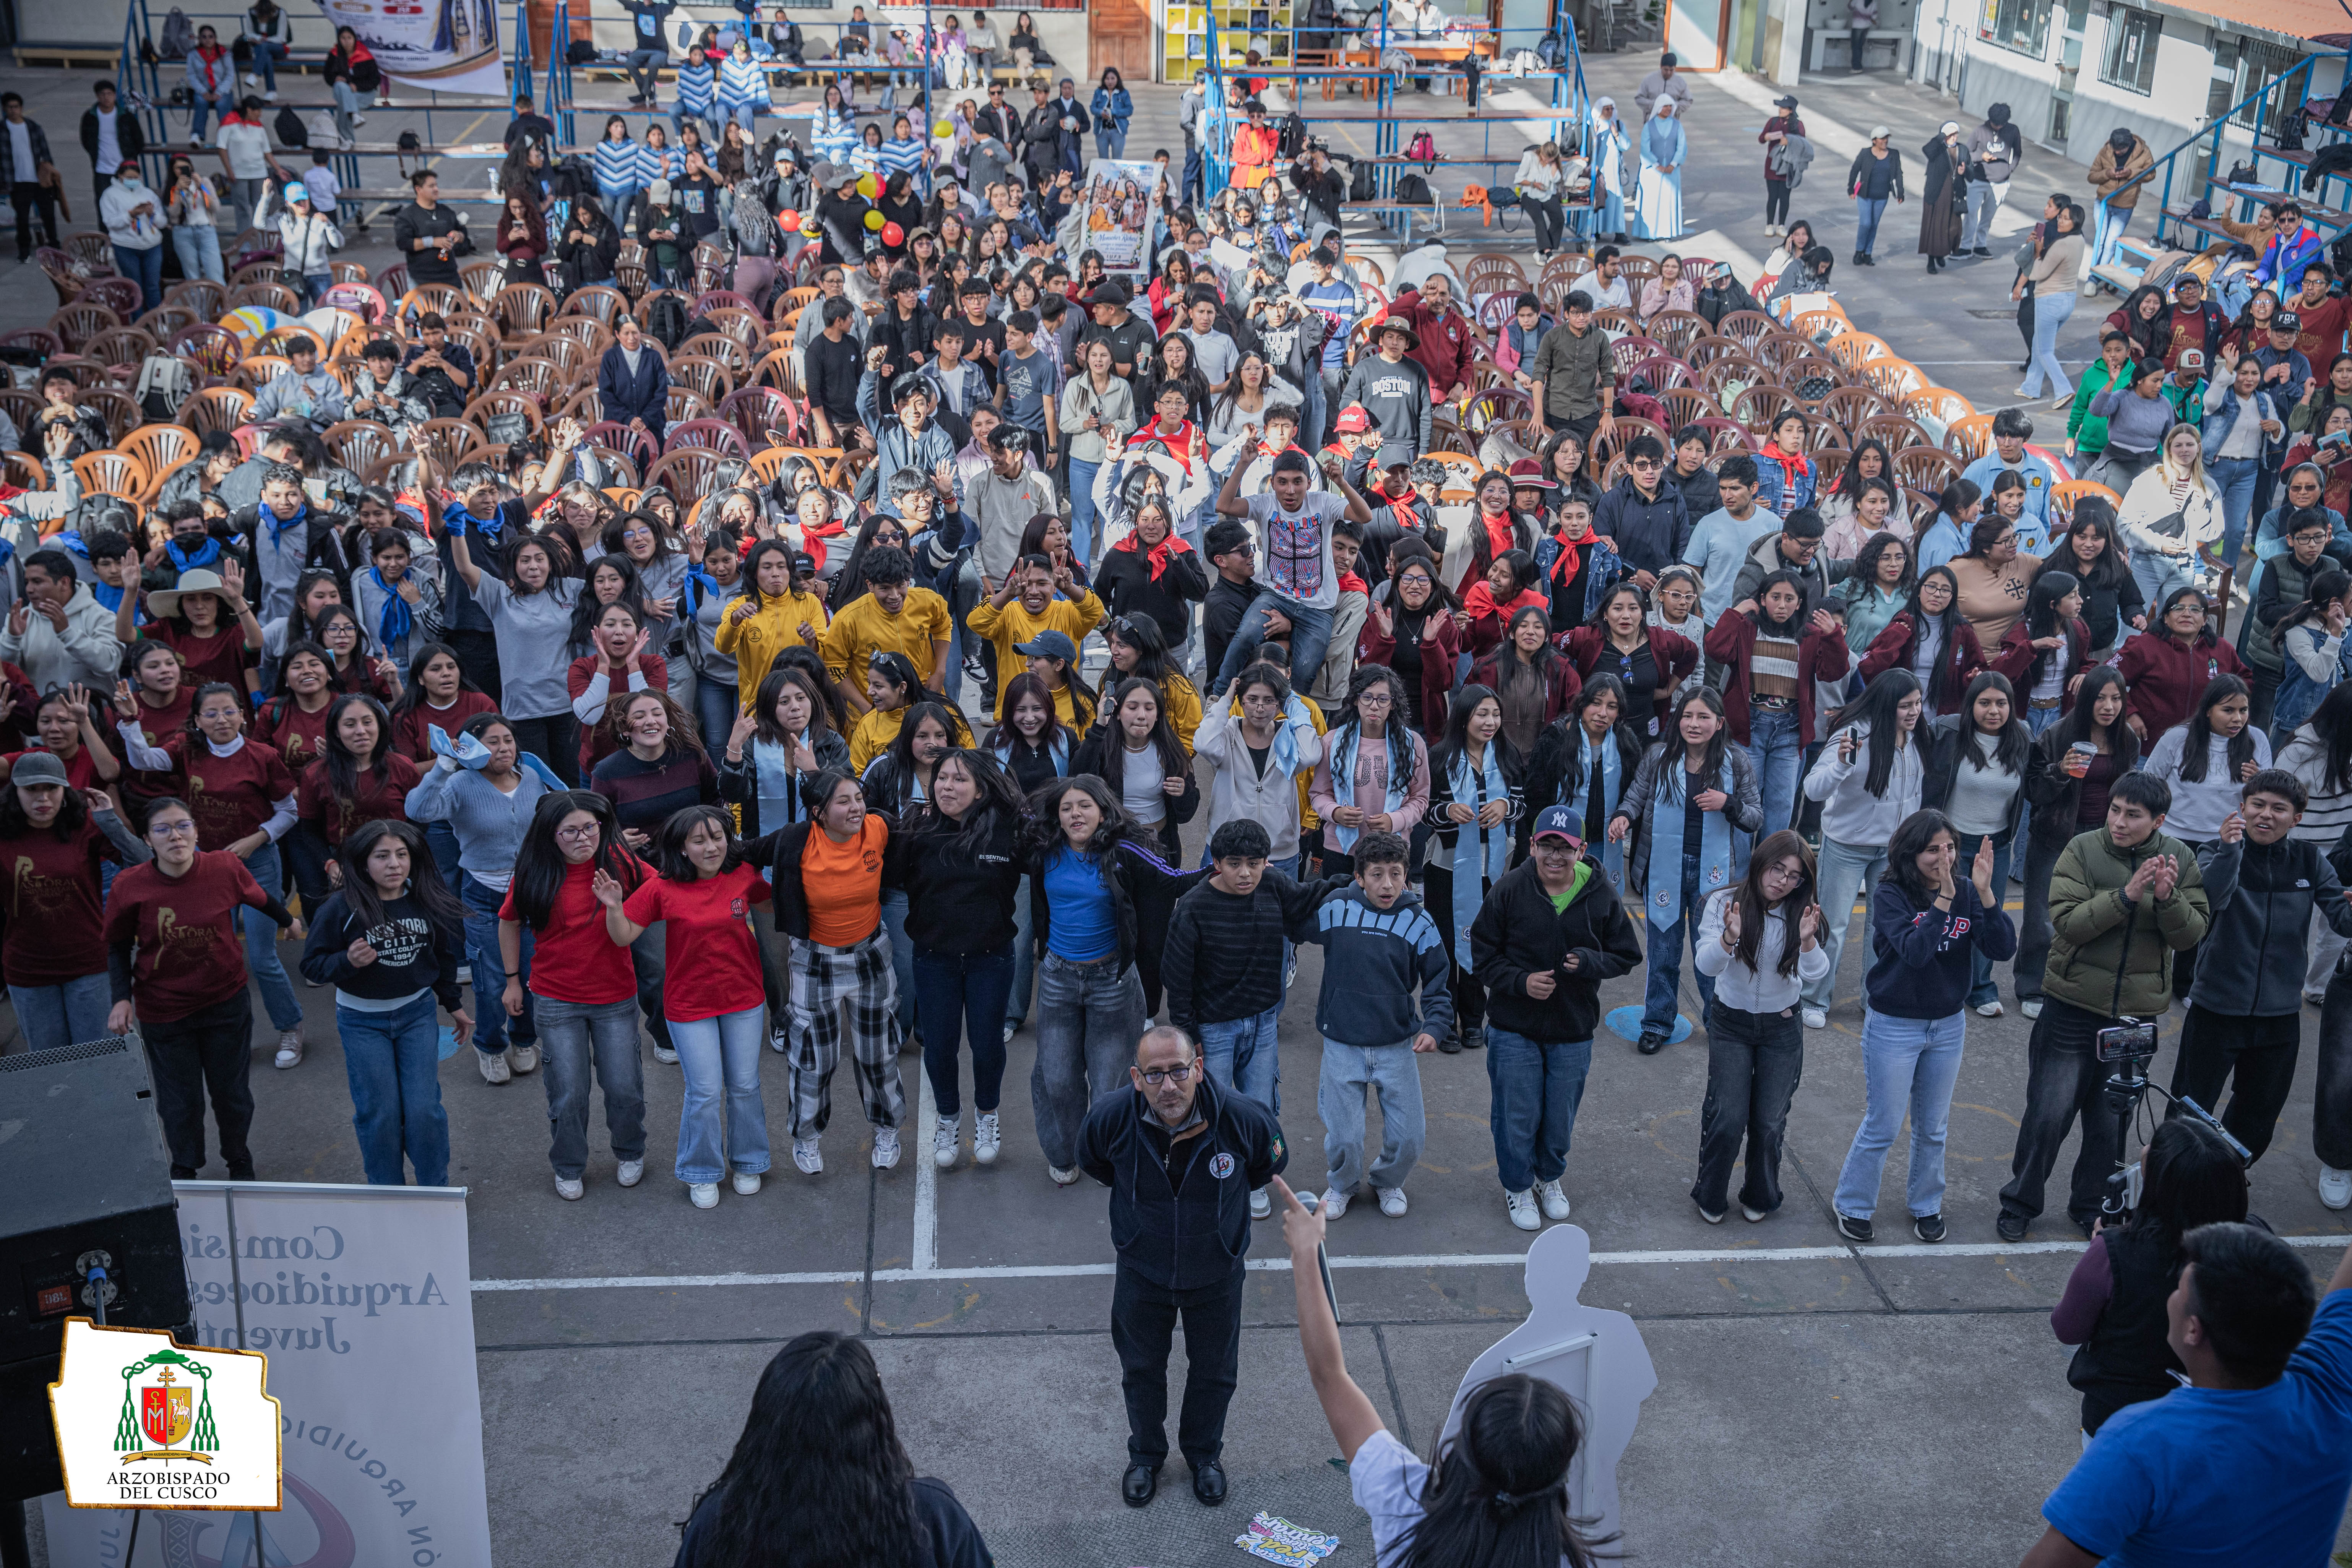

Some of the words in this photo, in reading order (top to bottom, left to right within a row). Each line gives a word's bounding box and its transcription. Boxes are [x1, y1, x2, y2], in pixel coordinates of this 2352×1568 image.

[2279, 313, 2295, 322] FOX
[1372, 379, 1411, 396] BOSTON
[1302, 513, 1322, 528] DOC?
[384, 935, 417, 948] CITY
[377, 948, 397, 956] STATE
[393, 952, 412, 961] 1994
[378, 958, 408, 967] AMERICAN
[1249, 1522, 1274, 1537] que
[1261, 1519, 1326, 1545] entrar
[1257, 1537, 1308, 1558] red
[1283, 1557, 1304, 1567] En
